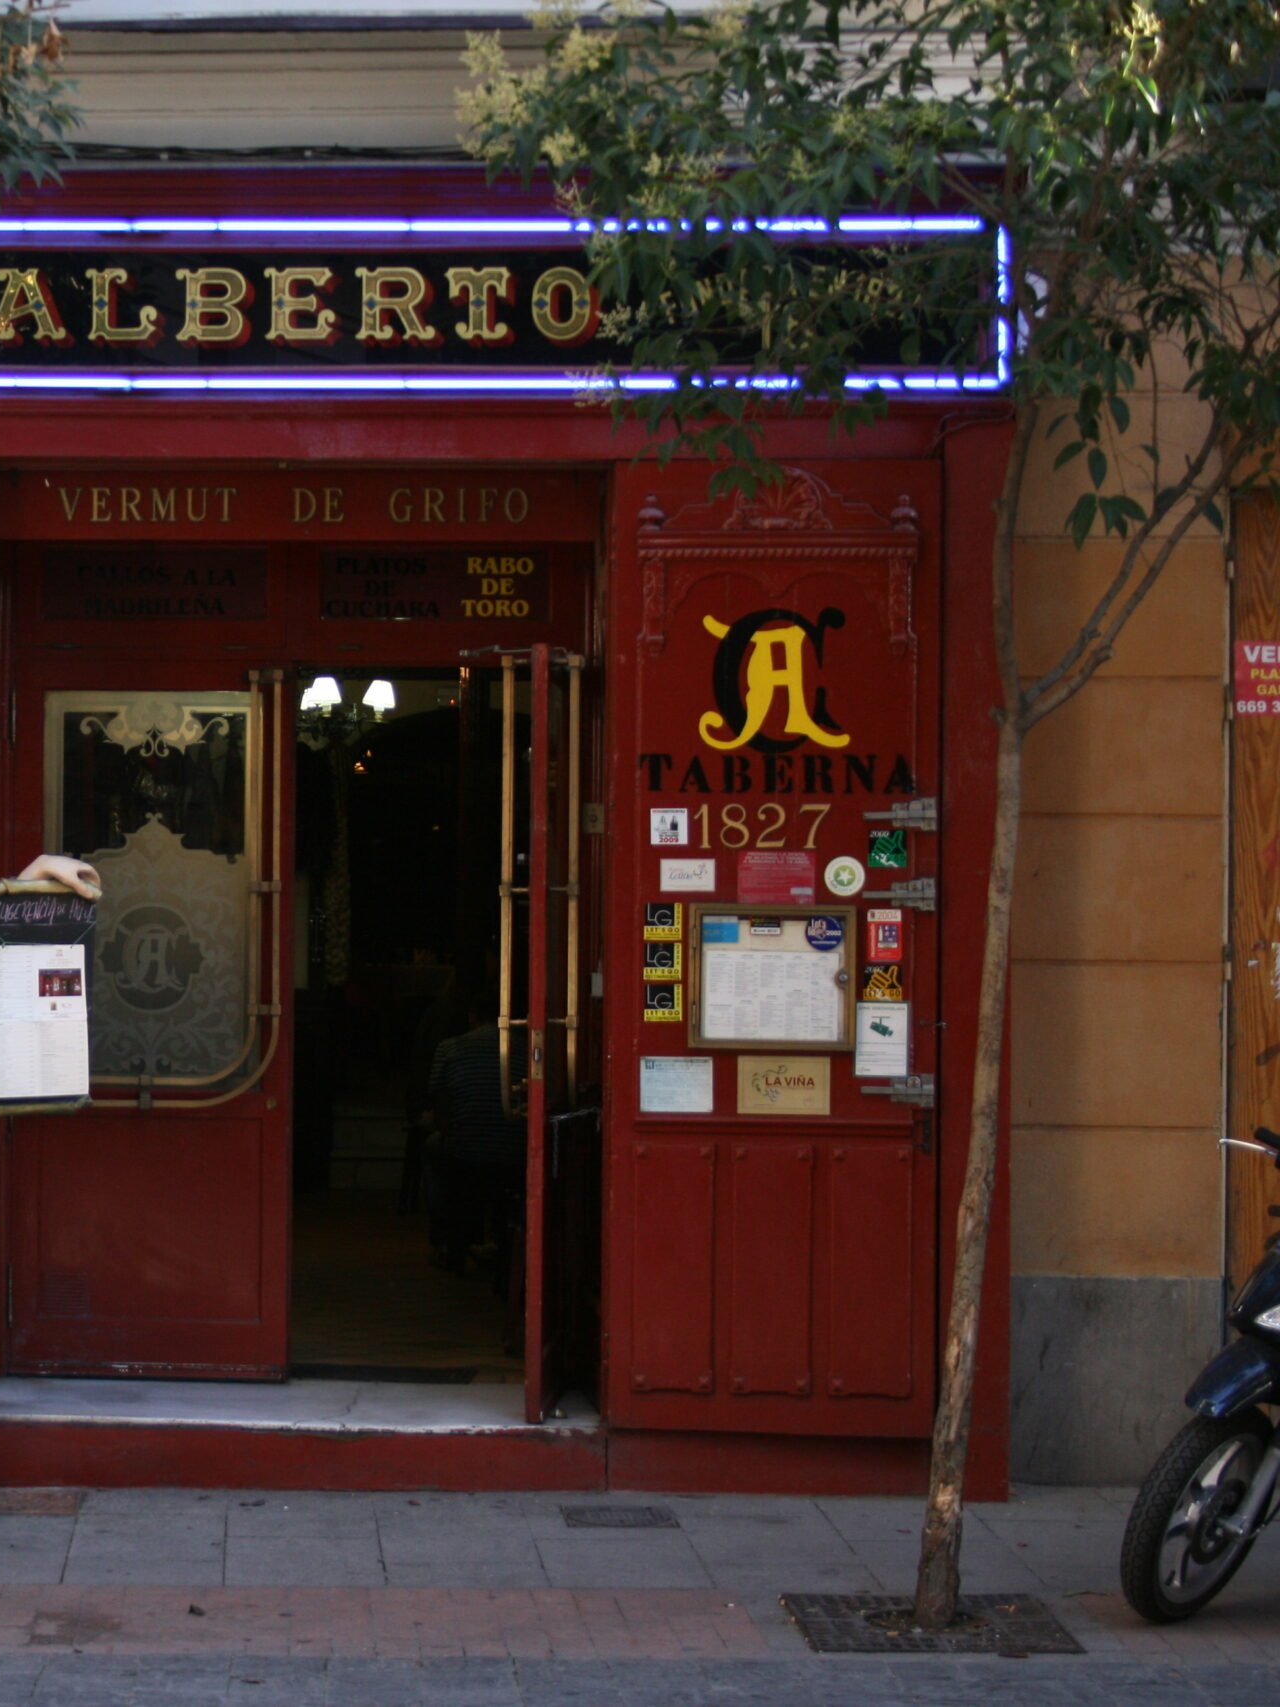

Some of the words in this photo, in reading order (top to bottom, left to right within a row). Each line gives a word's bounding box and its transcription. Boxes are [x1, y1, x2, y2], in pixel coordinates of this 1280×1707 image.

[57, 486, 238, 523] VERMUT
[292, 486, 345, 523] DE
[388, 486, 530, 523] GRIFO
[335, 556, 428, 577] PLATOS
[466, 556, 535, 576] RABO
[363, 579, 394, 598] DE
[480, 577, 515, 597] DE
[325, 599, 440, 618] CUCHARA
[461, 598, 530, 618] TORO
[1243, 645, 1280, 663] VE
[1256, 684, 1280, 695] GA
[1237, 701, 1267, 713] 669
[639, 753, 915, 795] TABERNA
[693, 803, 832, 849] 1827
[765, 1077, 782, 1087] LA
[784, 1074, 816, 1087] VIÑA
